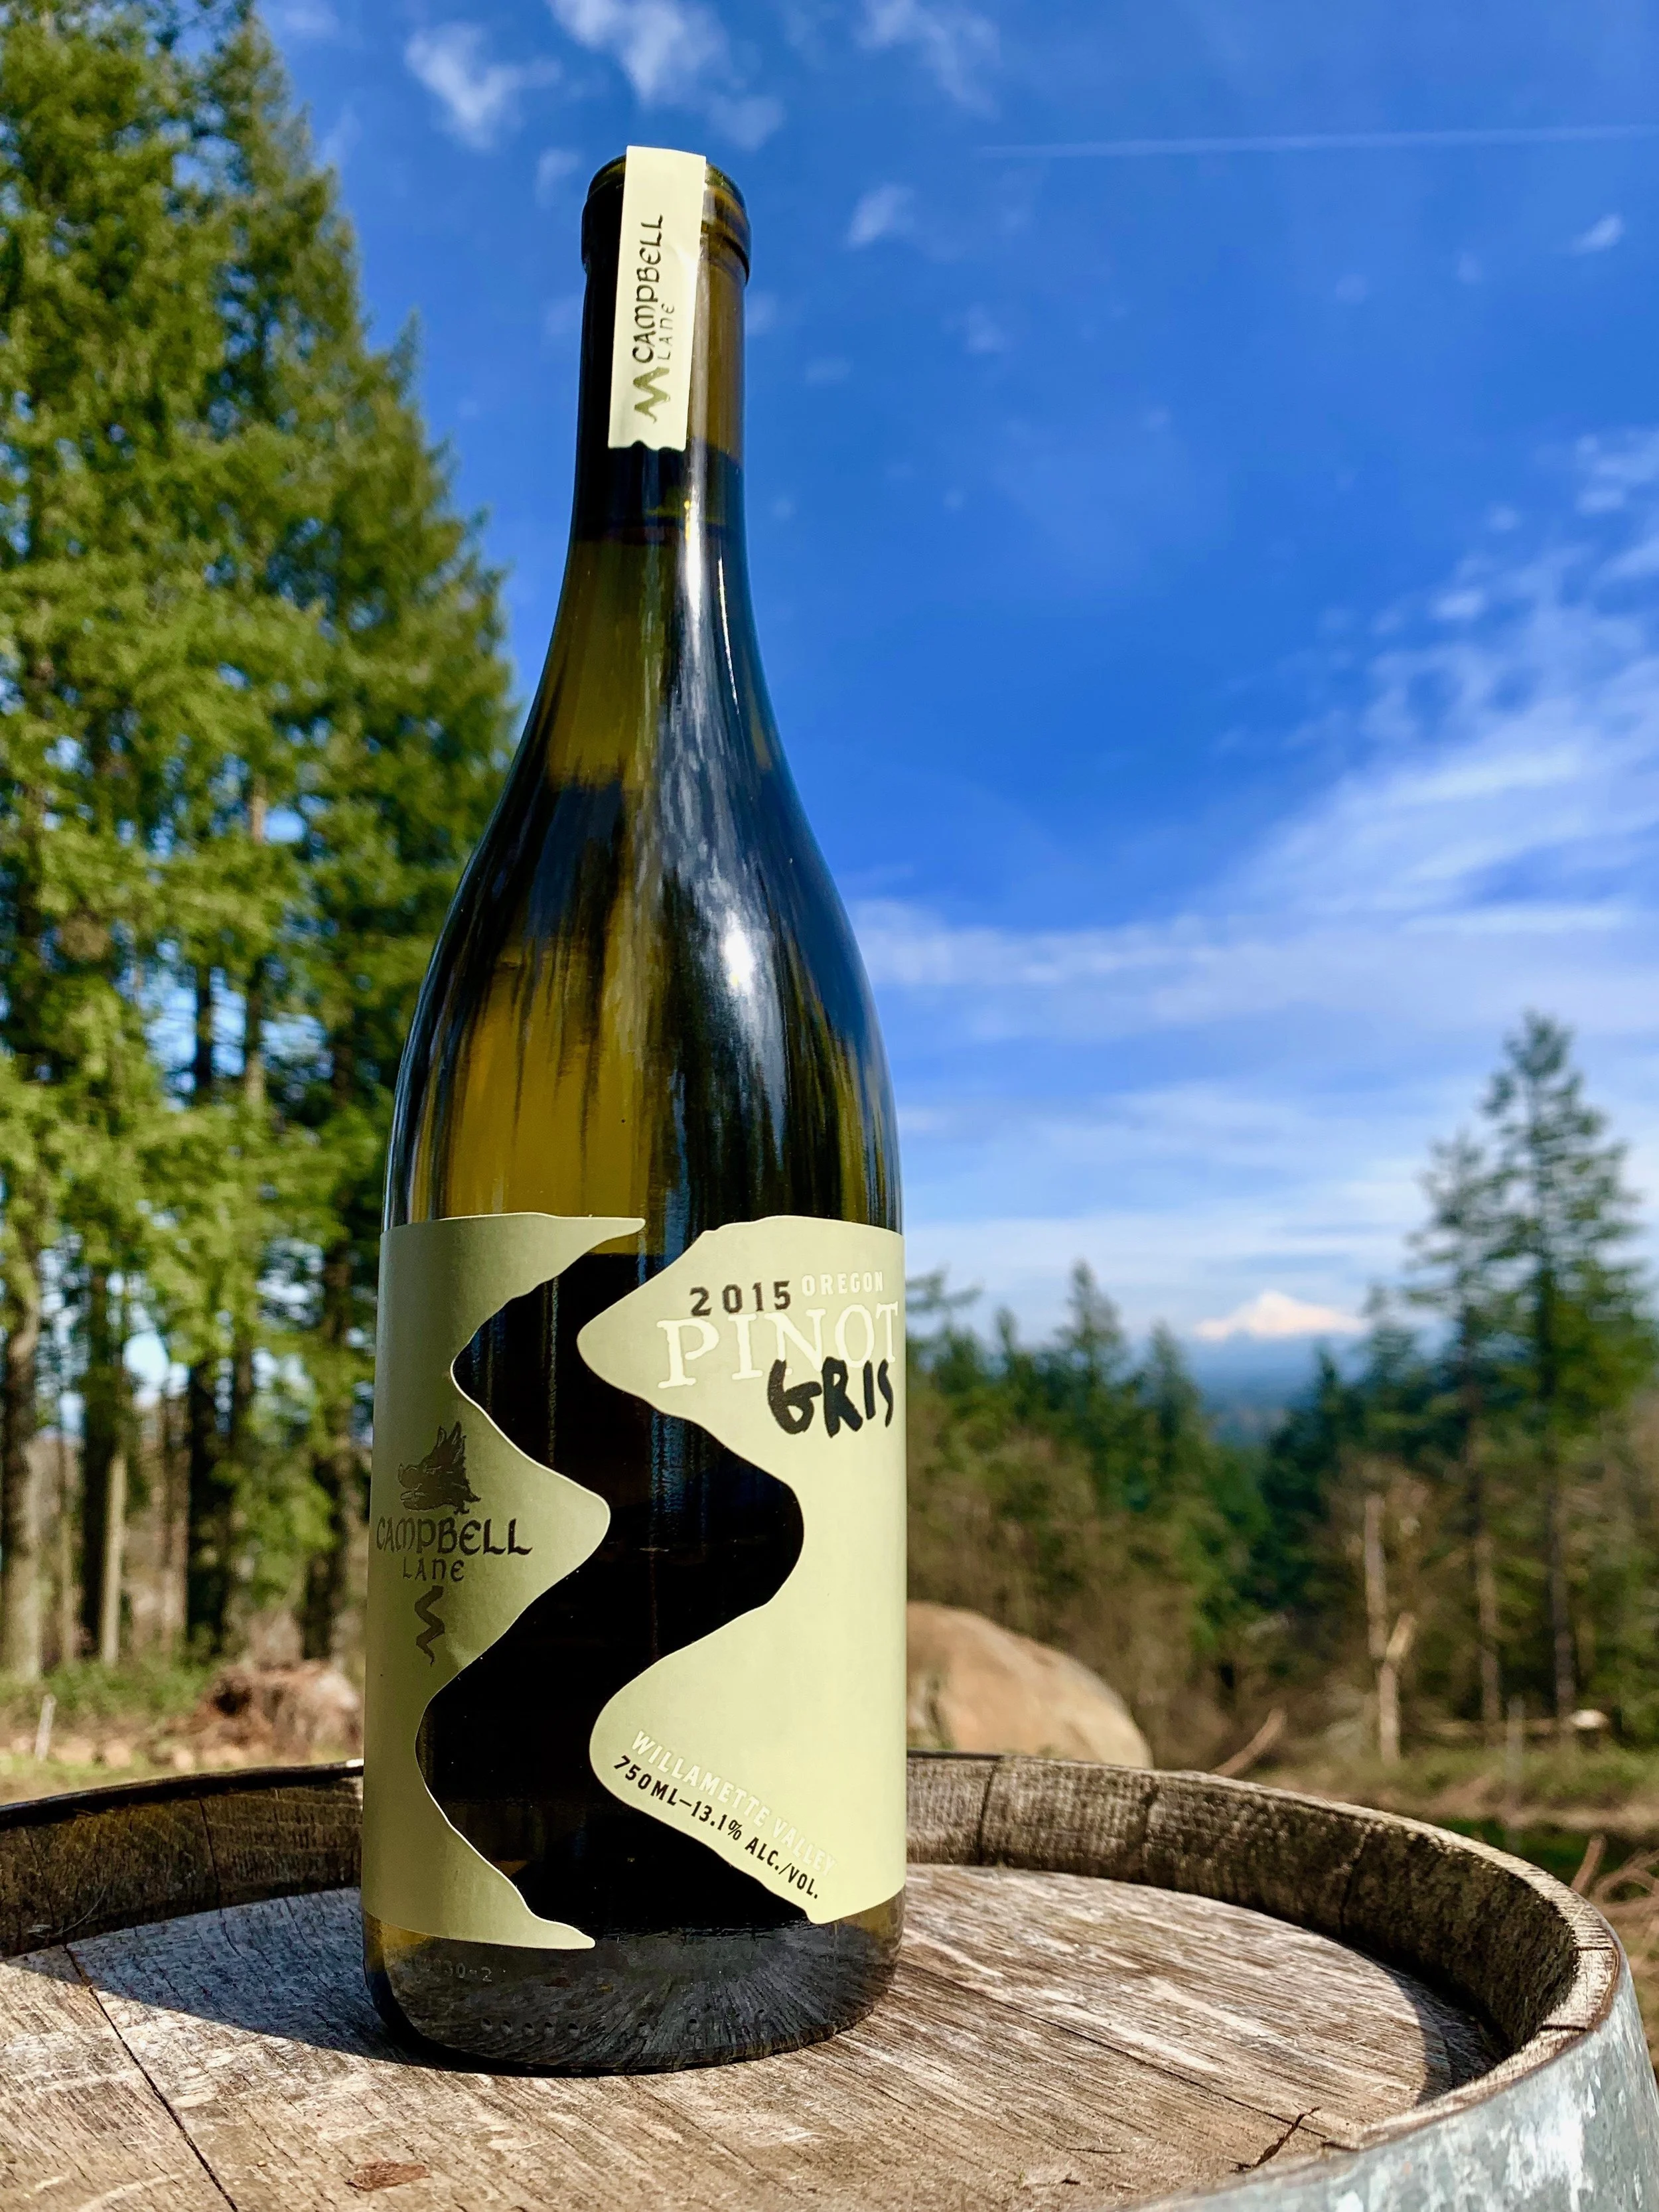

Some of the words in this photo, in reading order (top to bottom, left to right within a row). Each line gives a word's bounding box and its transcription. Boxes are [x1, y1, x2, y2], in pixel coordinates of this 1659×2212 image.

[632, 214, 663, 364] CAMPBELL
[689, 1280, 792, 1317] 2015
[801, 1271, 884, 1297] OREGON
[656, 1301, 899, 1389] PINOT
[767, 1356, 894, 1438] GRIS
[376, 1516, 533, 1556] CAMPBELL
[631, 1730, 772, 1828] WILLAMETTE
[772, 1816, 837, 1877] VALLEY
[745, 1836, 818, 1899] ALC./VOL.
